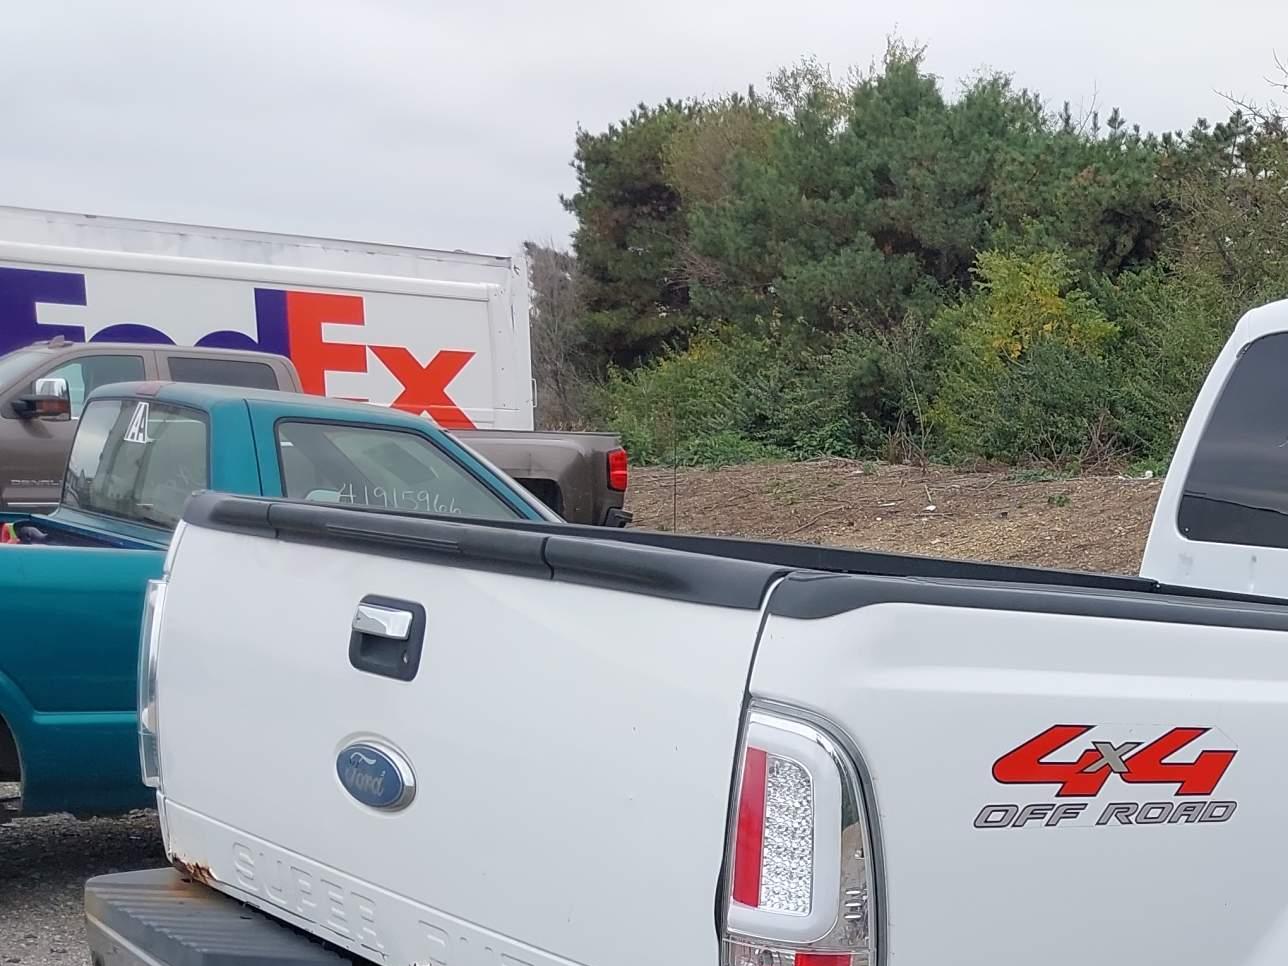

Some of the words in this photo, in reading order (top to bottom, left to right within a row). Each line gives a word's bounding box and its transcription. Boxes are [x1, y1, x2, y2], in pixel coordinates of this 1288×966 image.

[337, 483, 462, 514] 41915966
[345, 751, 386, 797] Ford
[973, 803, 1088, 828] OFF
[1095, 801, 1237, 825] ROAD
[231, 841, 386, 951] SUPER
